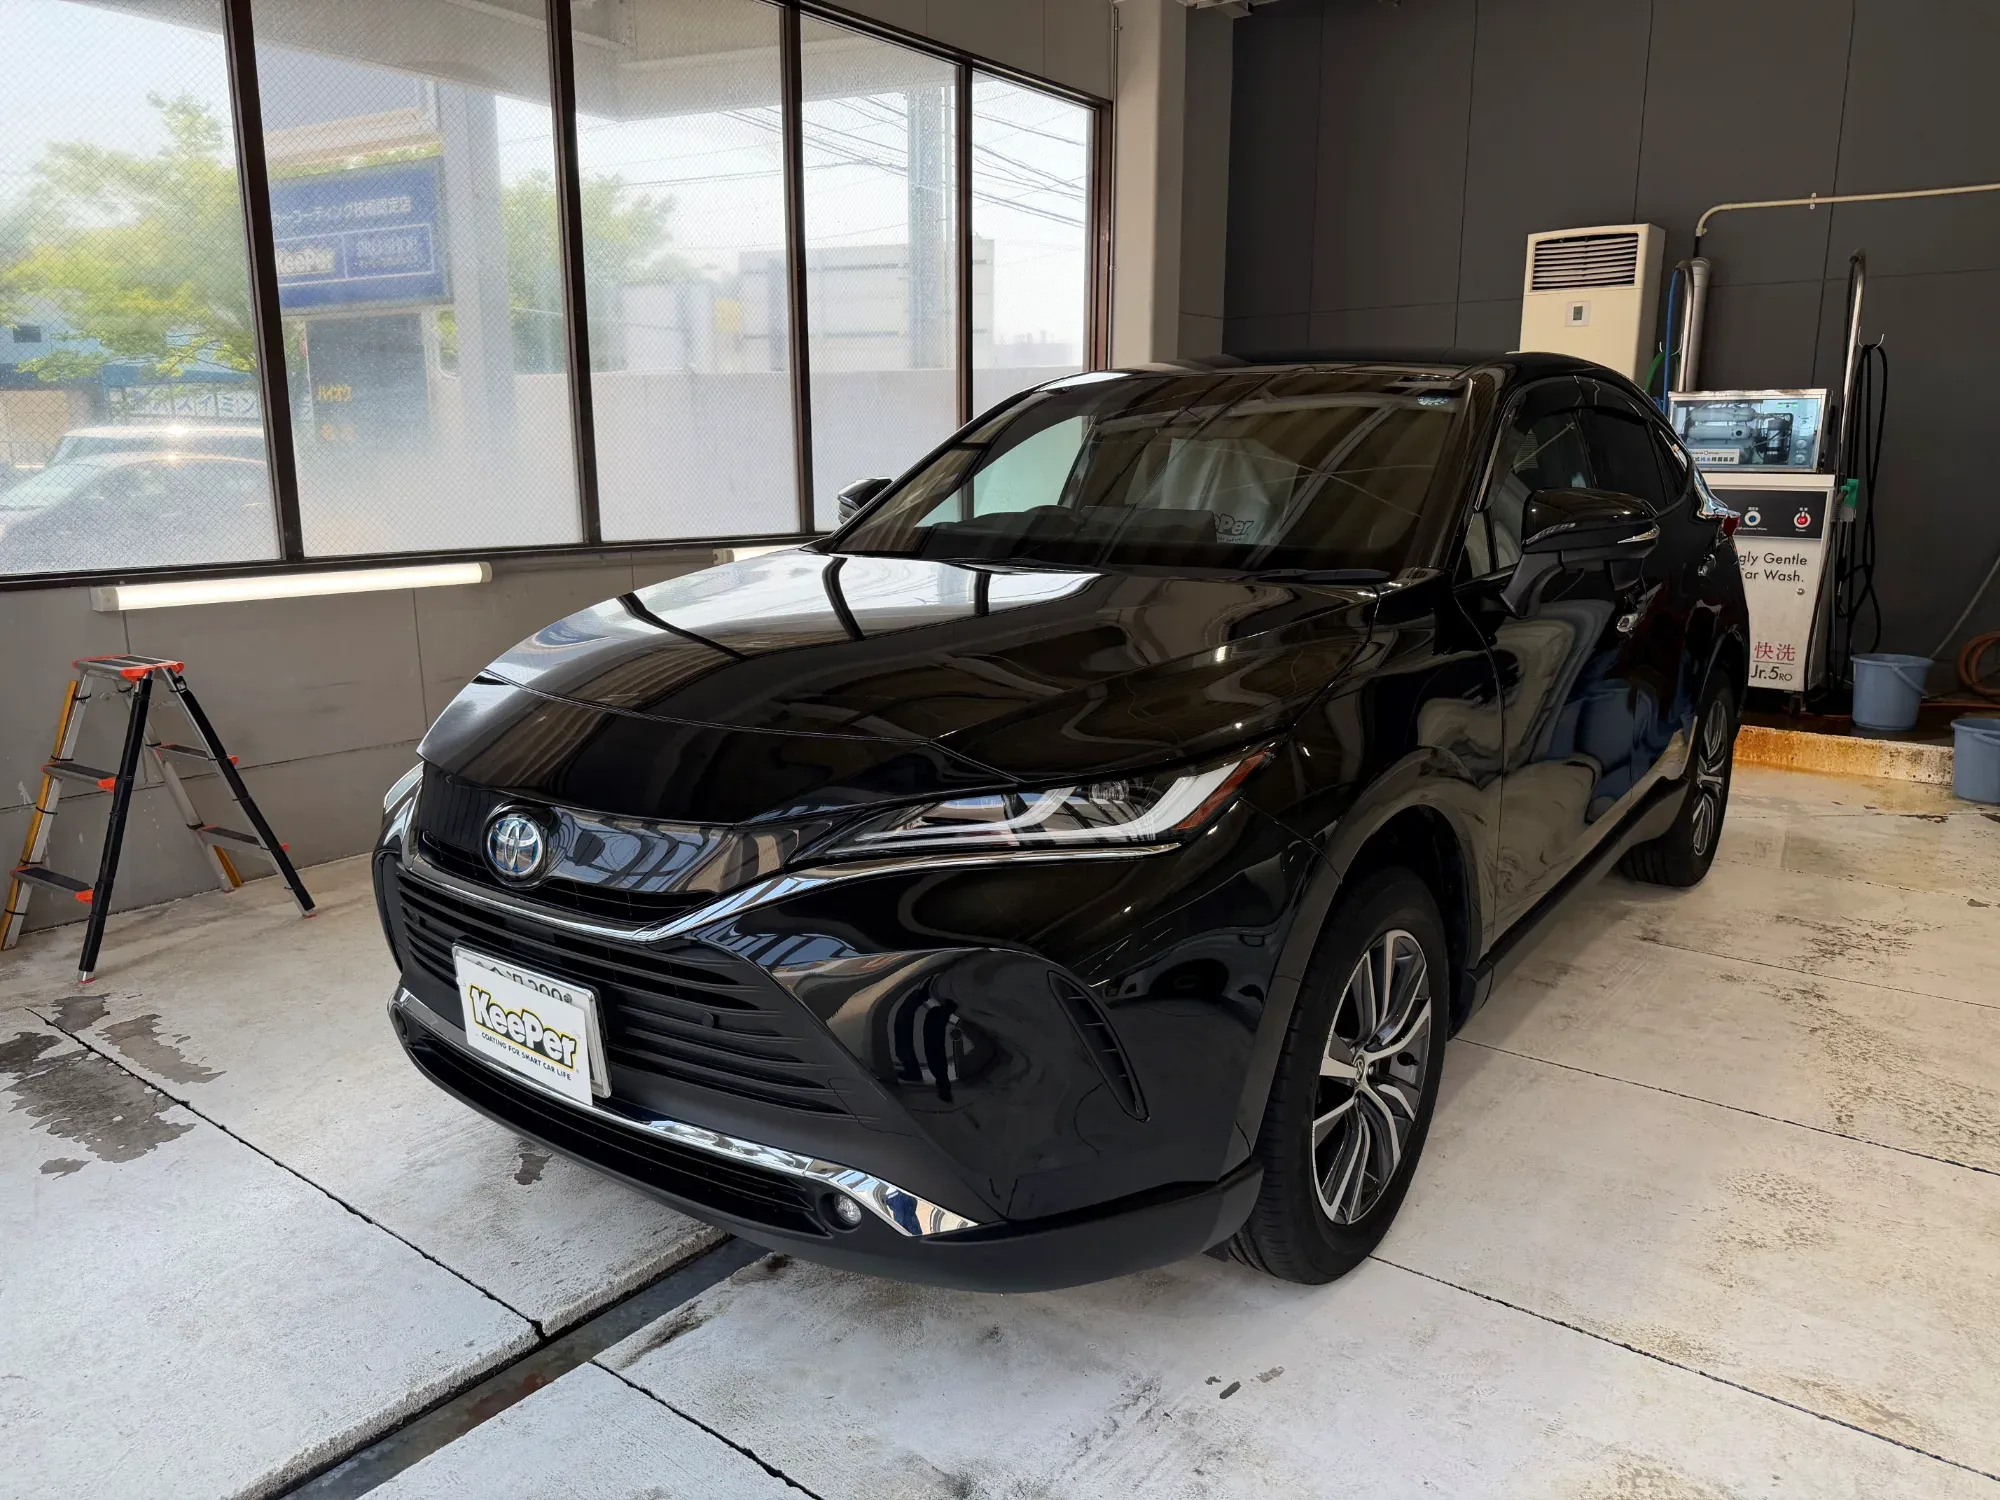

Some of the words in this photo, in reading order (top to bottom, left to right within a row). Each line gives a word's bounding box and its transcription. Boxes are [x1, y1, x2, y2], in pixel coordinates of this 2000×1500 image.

[1763, 552, 1807, 566] Gentle
[1741, 567, 1759, 580] ar
[1763, 568, 1804, 582] Wash.
[1754, 641, 1796, 661] 快洗
[468, 983, 578, 1071] KeePer
[481, 1032, 507, 1050] COATING
[508, 1044, 521, 1057] FOR
[521, 1052, 542, 1067] SMART
[543, 1062, 556, 1074] CAR
[556, 1068, 572, 1081] LIFE
